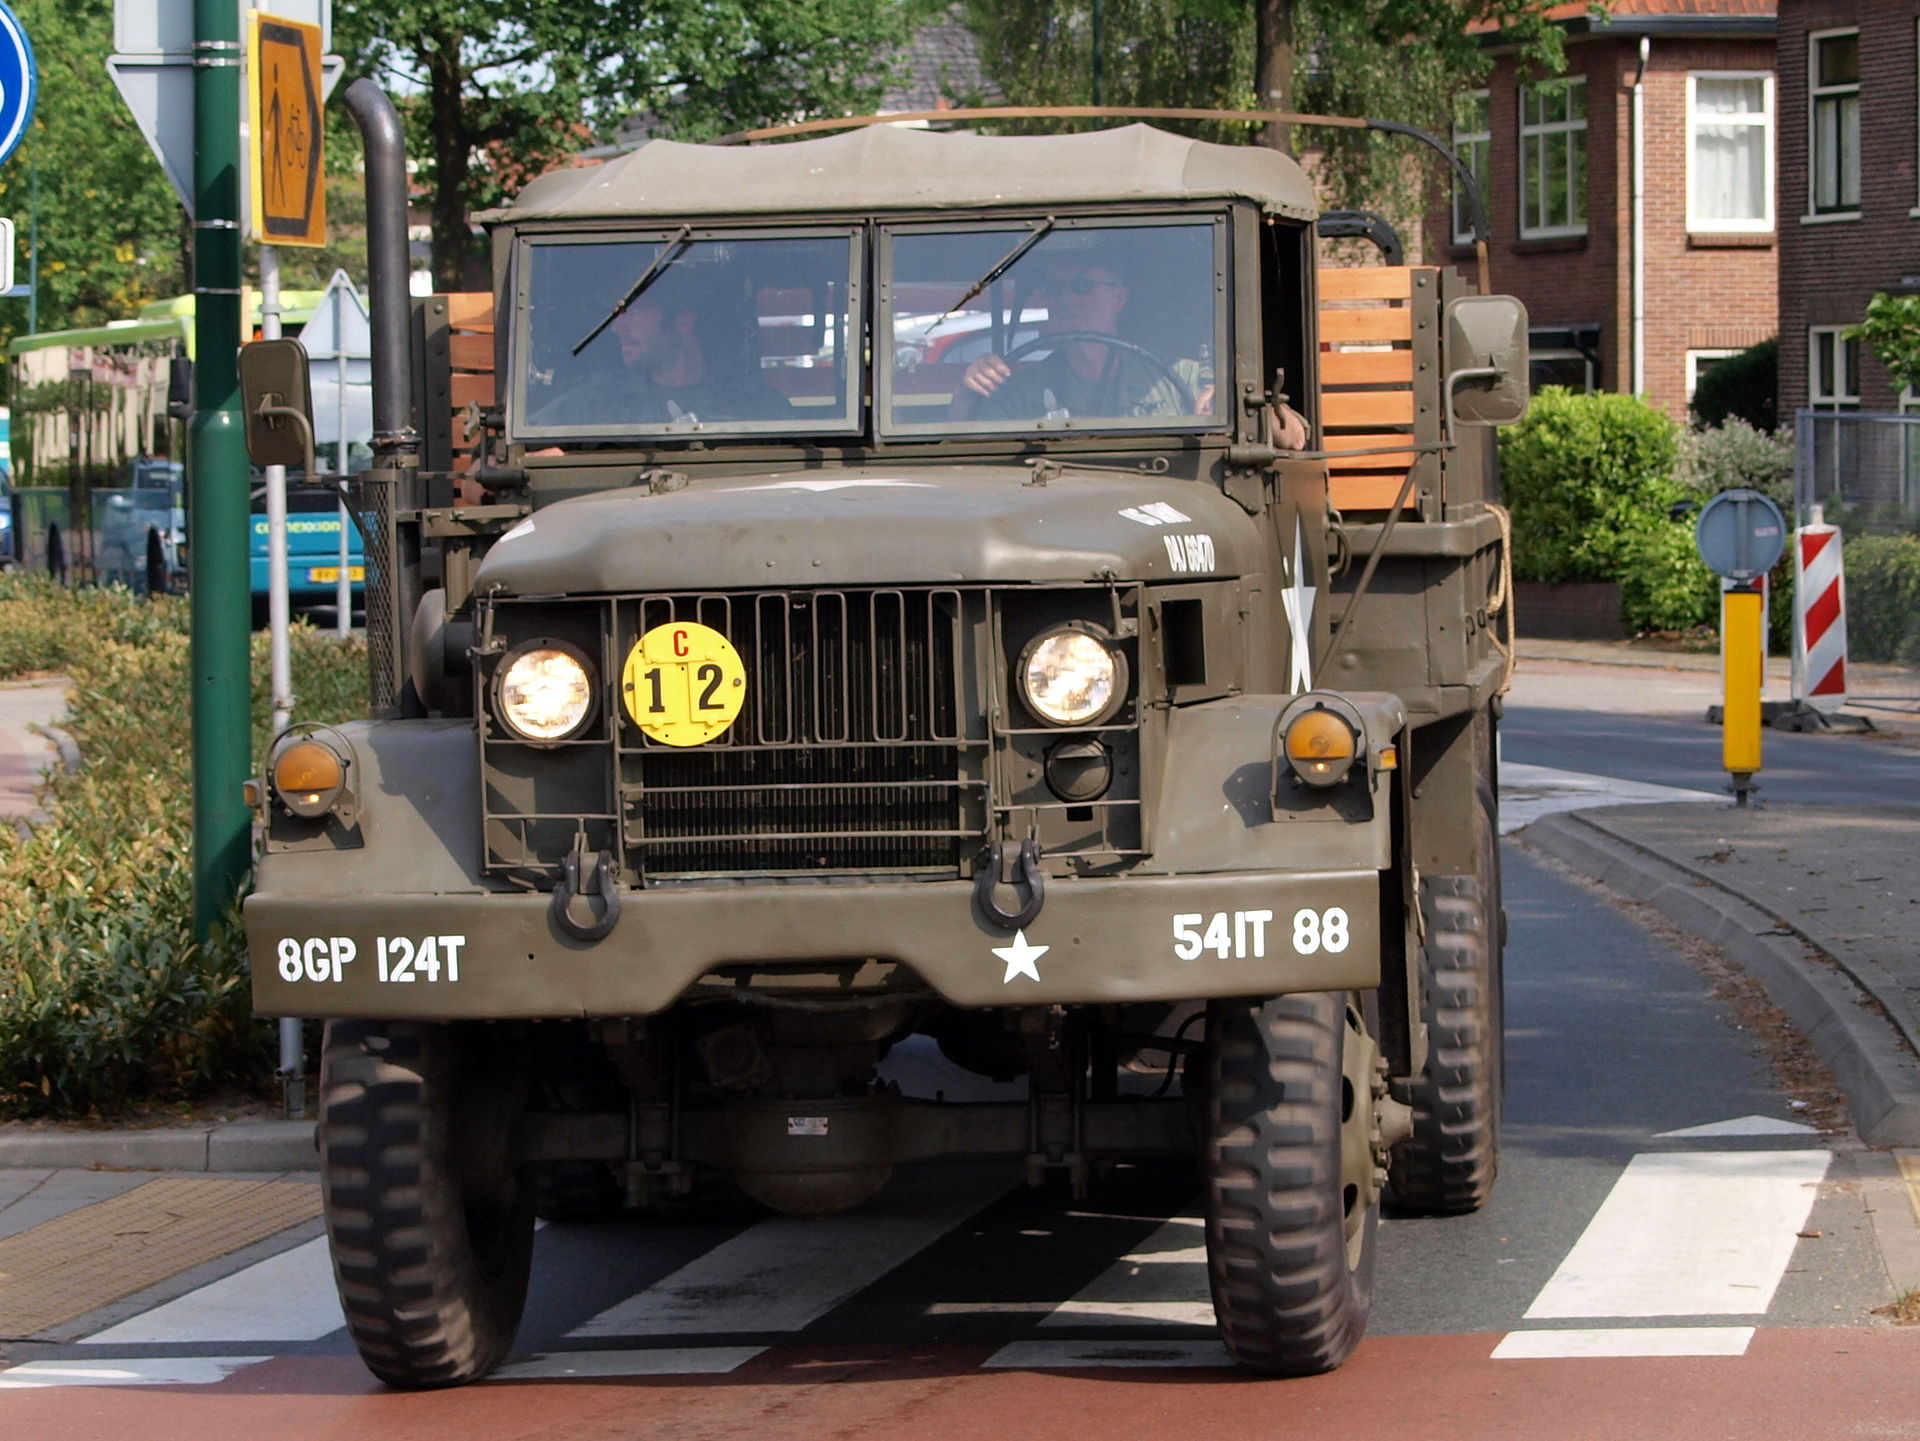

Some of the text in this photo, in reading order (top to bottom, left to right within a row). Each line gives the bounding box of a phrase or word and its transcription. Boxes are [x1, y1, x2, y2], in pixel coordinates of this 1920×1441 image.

[673, 630, 689, 657] C
[1292, 906, 1350, 956] 88
[277, 937, 357, 983] 8GP
